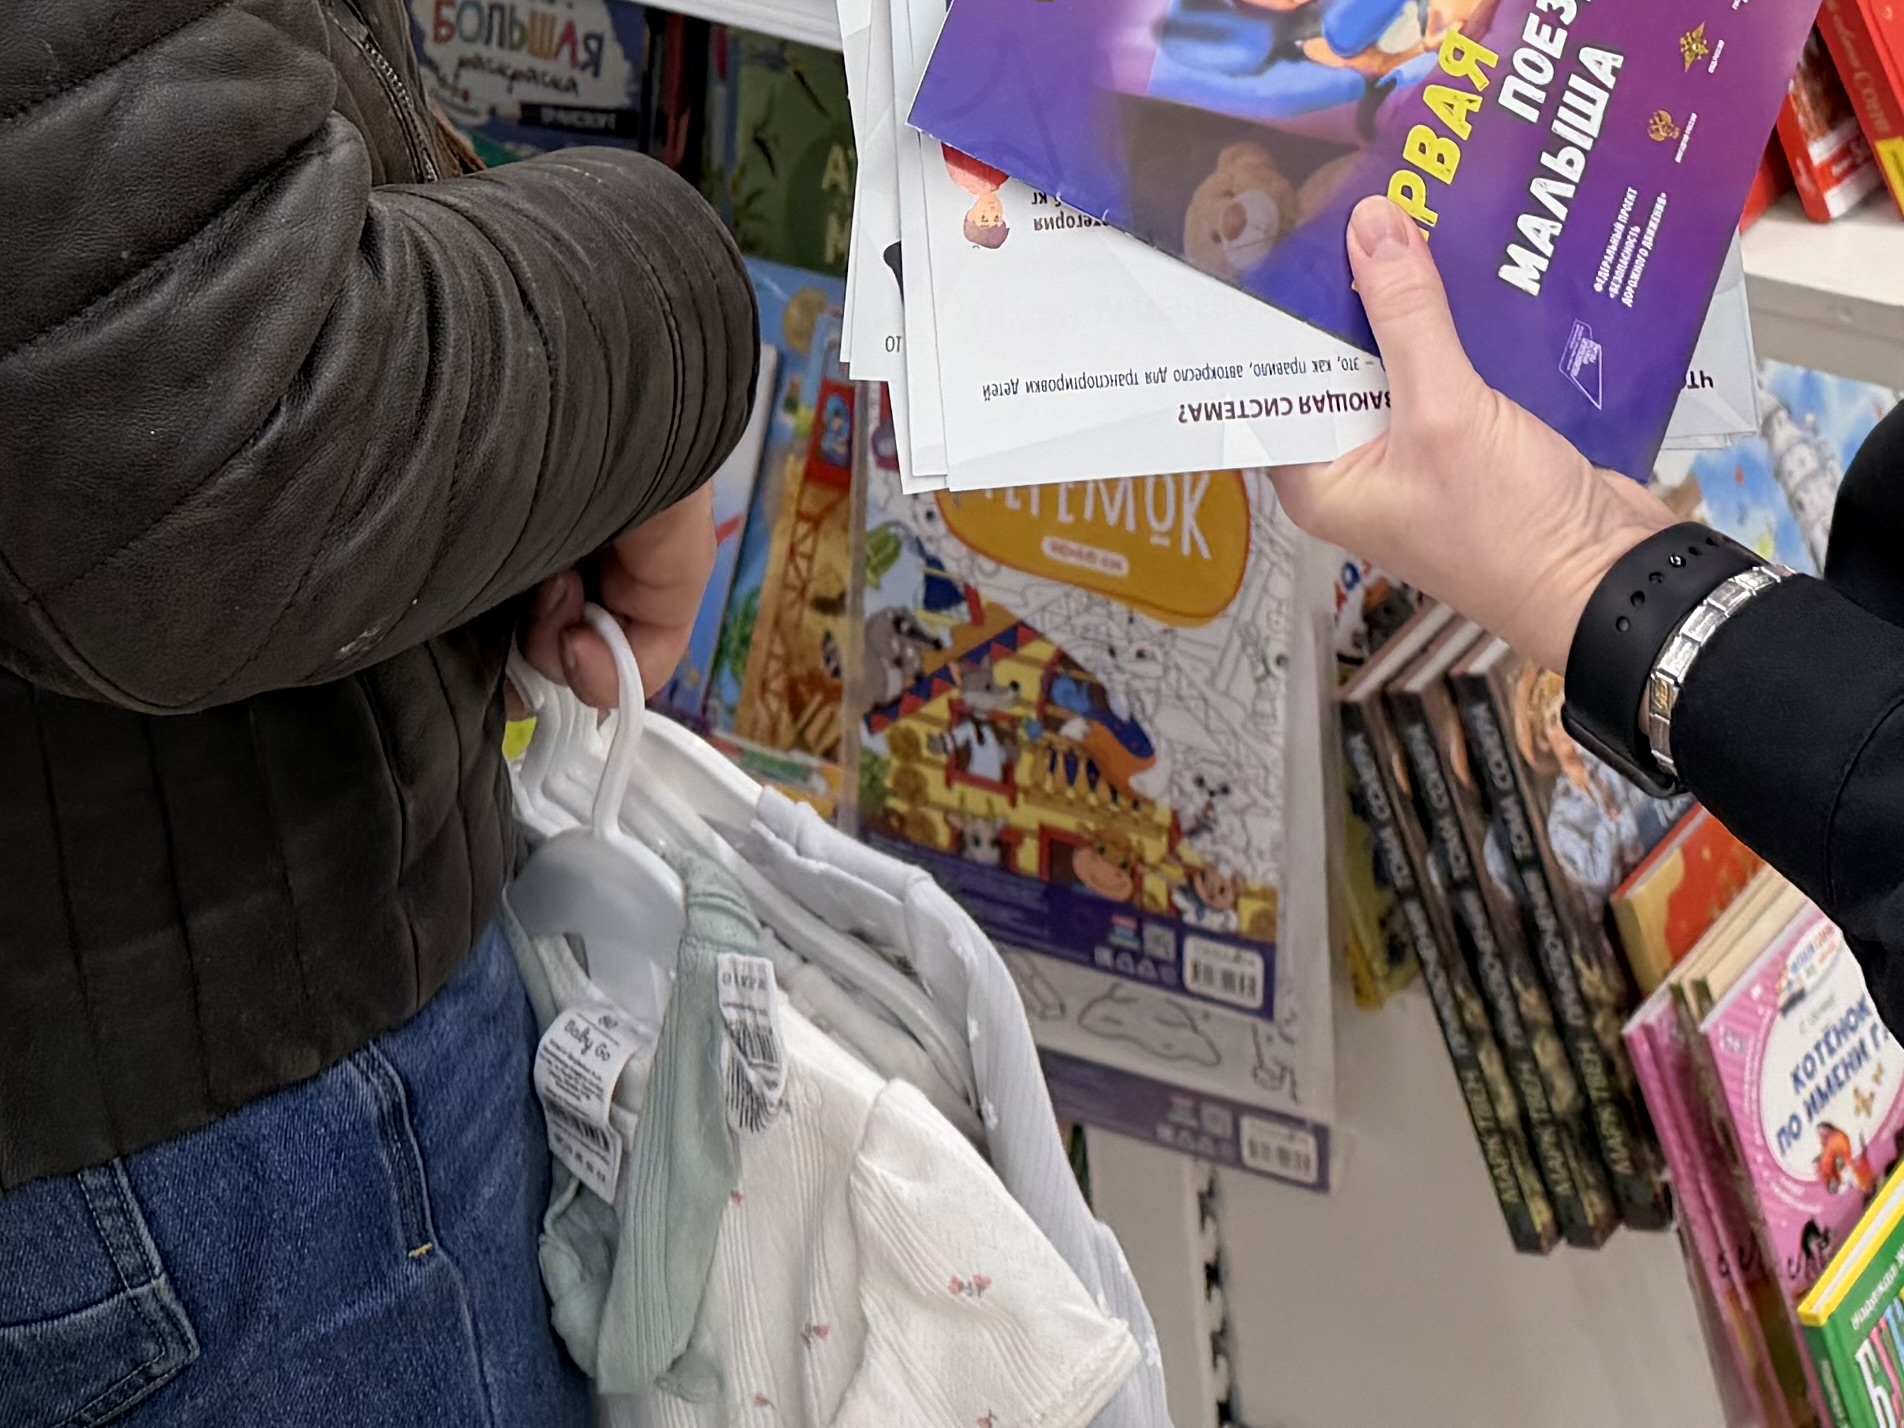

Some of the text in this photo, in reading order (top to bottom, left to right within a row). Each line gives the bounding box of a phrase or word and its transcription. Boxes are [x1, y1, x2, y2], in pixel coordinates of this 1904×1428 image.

[1386, 28, 1500, 243] РВАЯ
[1497, 46, 1625, 298] МАЛЫША
[1592, 186, 1639, 294] ФЕДЕРАЛЬНЫЙ ПРОЕКТ
[1622, 249, 1650, 308] ДОРОЖНОГО
[1143, 369, 1169, 387] для
[1172, 365, 1244, 385] автокресло
[1247, 357, 1307, 379] правило,
[1311, 357, 1333, 374] как
[981, 379, 1020, 402] детей
[1024, 372, 1140, 397] транспортировки
[1176, 397, 1295, 425] СИСТЕМА?
[1789, 993, 1872, 1095] КОТЁНОК
[1776, 1049, 1870, 1158] ПО ИМЕНИ
